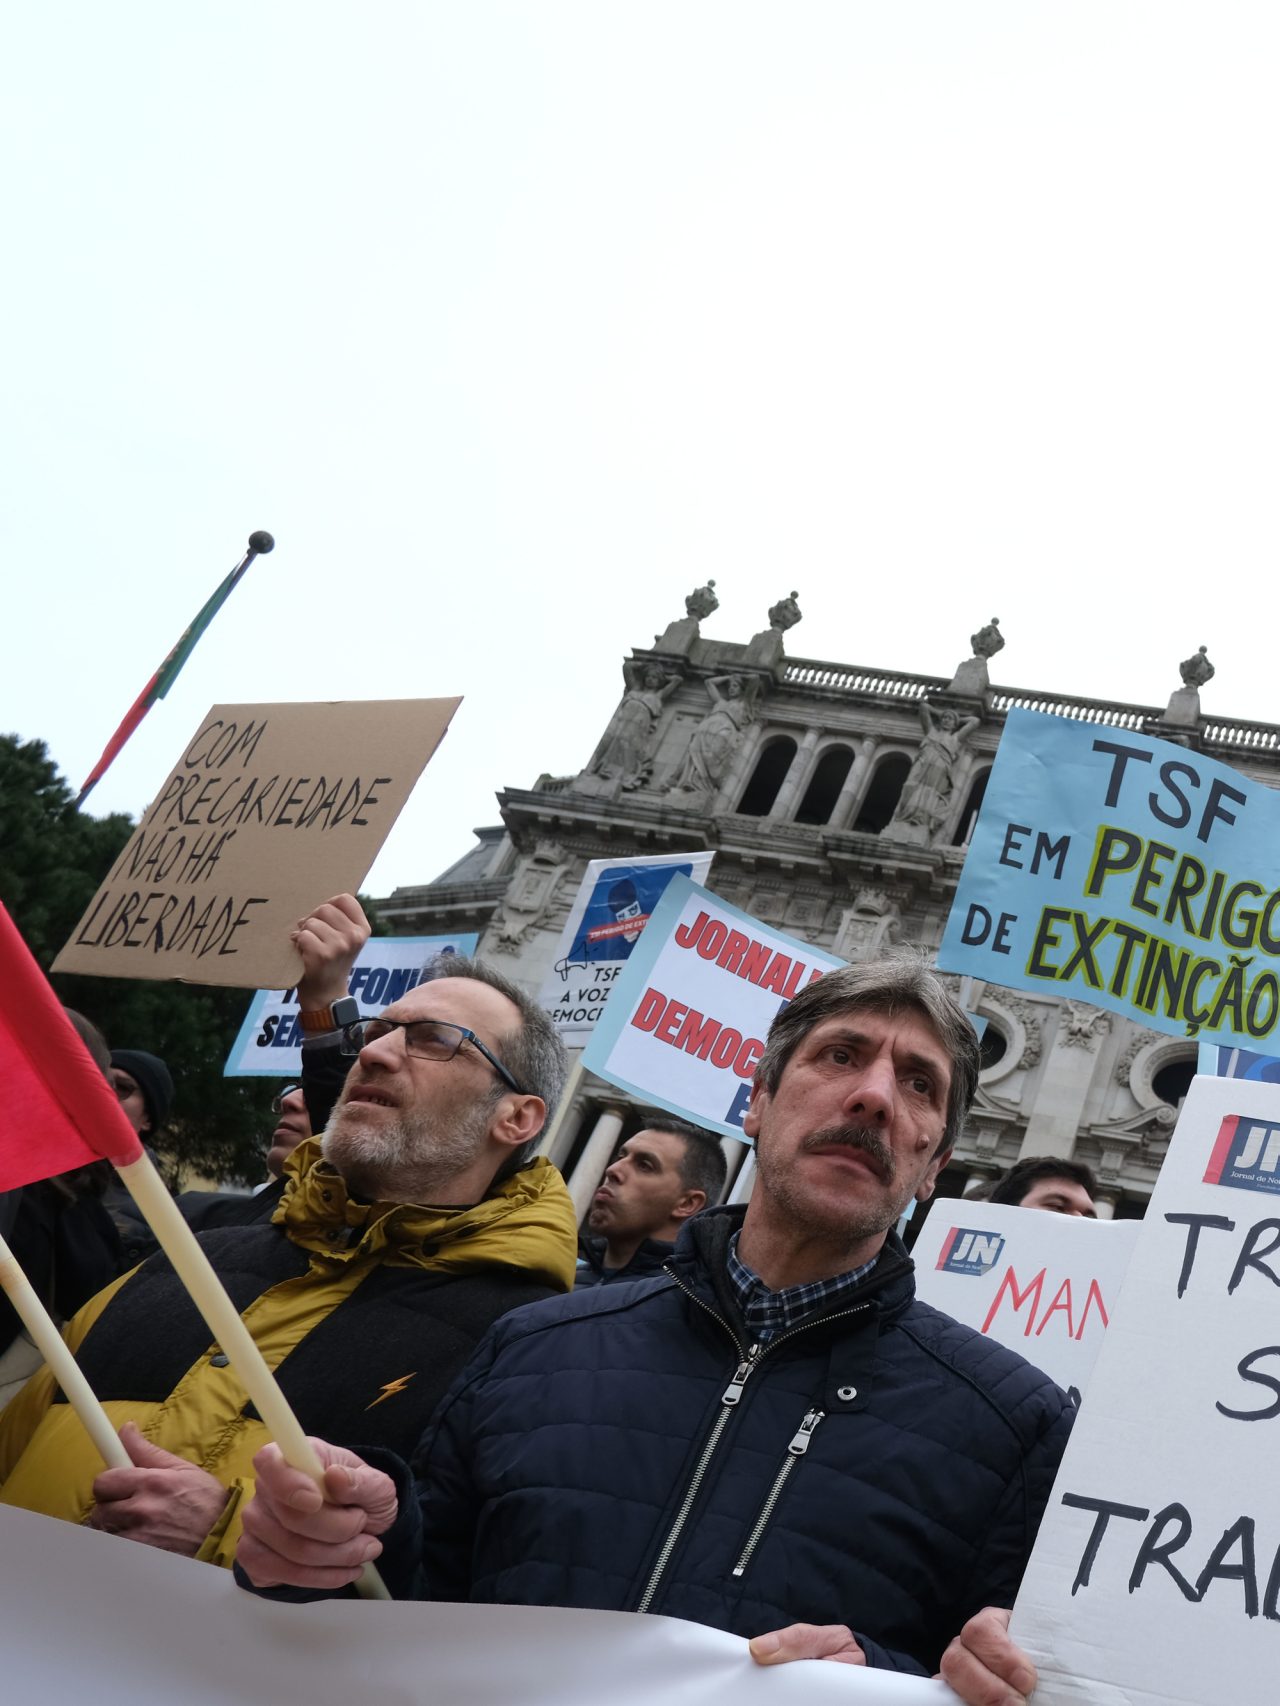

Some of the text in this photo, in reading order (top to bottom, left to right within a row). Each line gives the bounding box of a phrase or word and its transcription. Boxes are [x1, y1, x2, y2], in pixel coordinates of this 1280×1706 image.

[184, 719, 269, 769] COM
[148, 772, 393, 832] PRECARIEDADE
[1092, 739, 1247, 843] TSF
[112, 826, 238, 885] NÃO HÁ
[999, 823, 1071, 880] EM
[75, 890, 270, 959] LIBERDADE
[594, 966, 622, 982] TSF
[674, 911, 823, 1001] JORNAL
[960, 902, 1280, 1038] DE EXTINÇÃO
[560, 987, 611, 1003] A VOZ
[1230, 1170, 1255, 1181] Jornal
[1256, 1175, 1266, 1183] de
[951, 1233, 1001, 1265] JN
